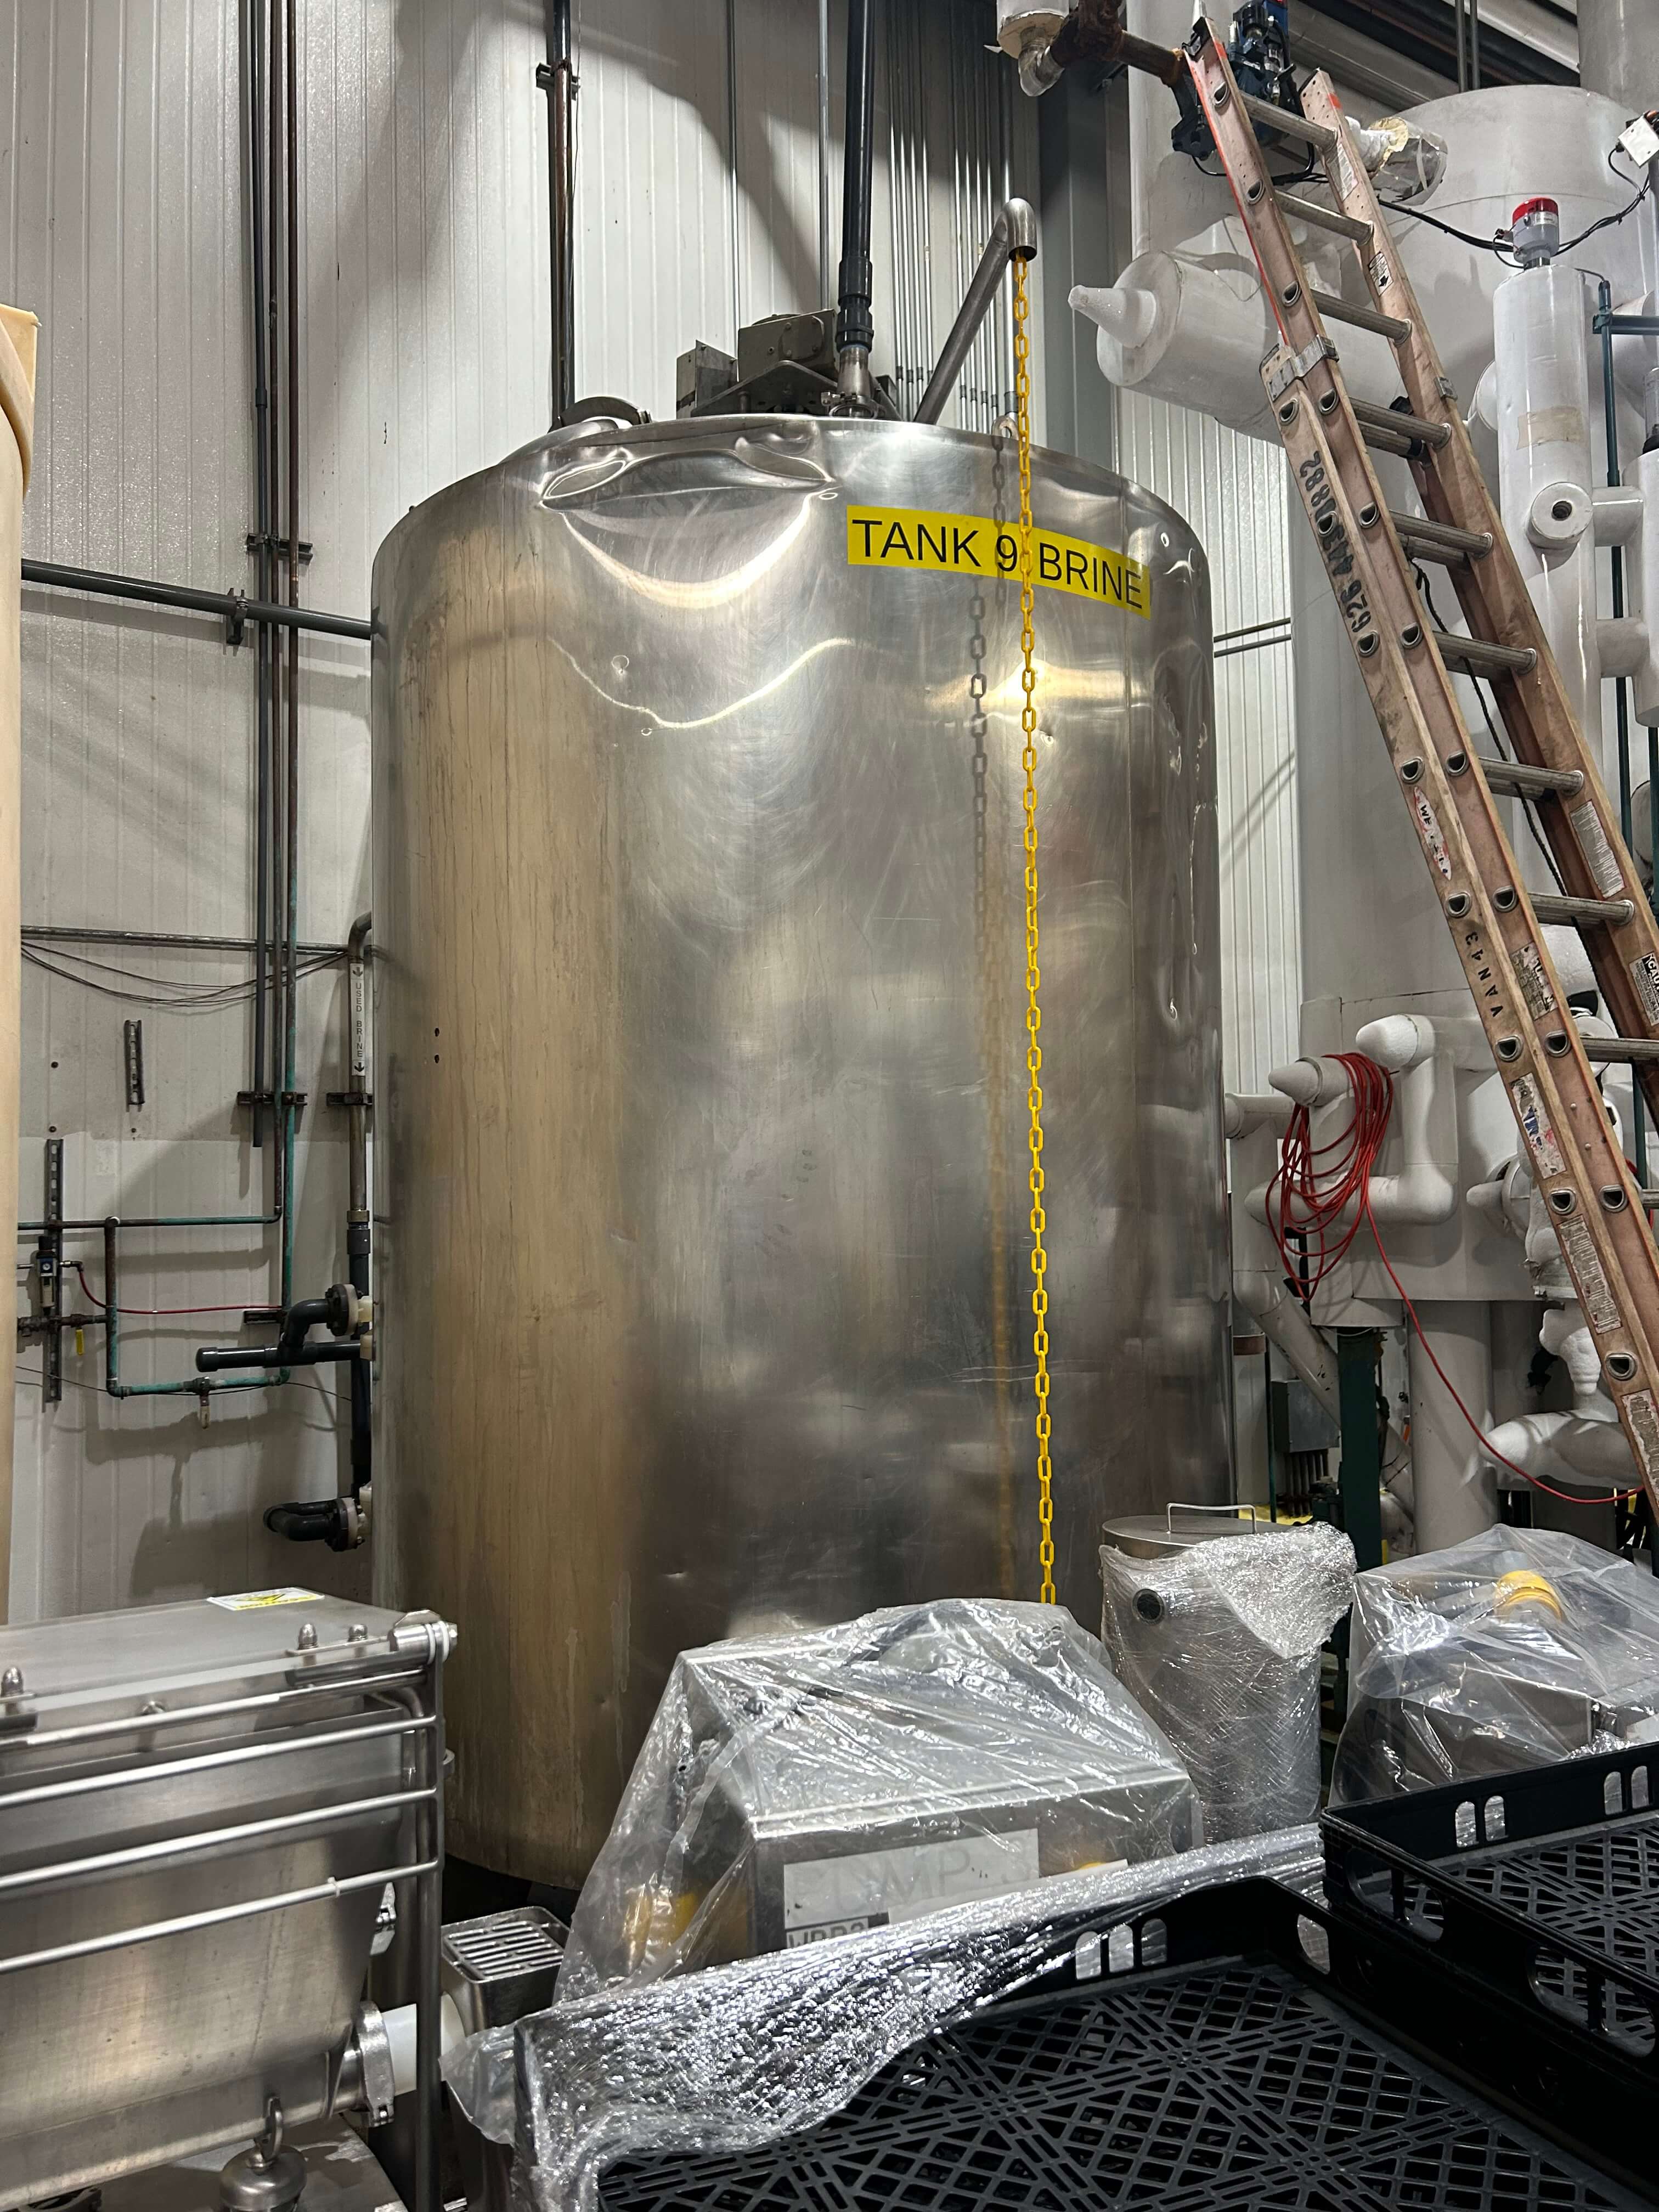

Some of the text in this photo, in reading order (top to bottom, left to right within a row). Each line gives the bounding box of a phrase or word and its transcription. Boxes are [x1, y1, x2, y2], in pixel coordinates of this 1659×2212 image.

[852, 518, 1143, 610] TANK 9 BRINE
